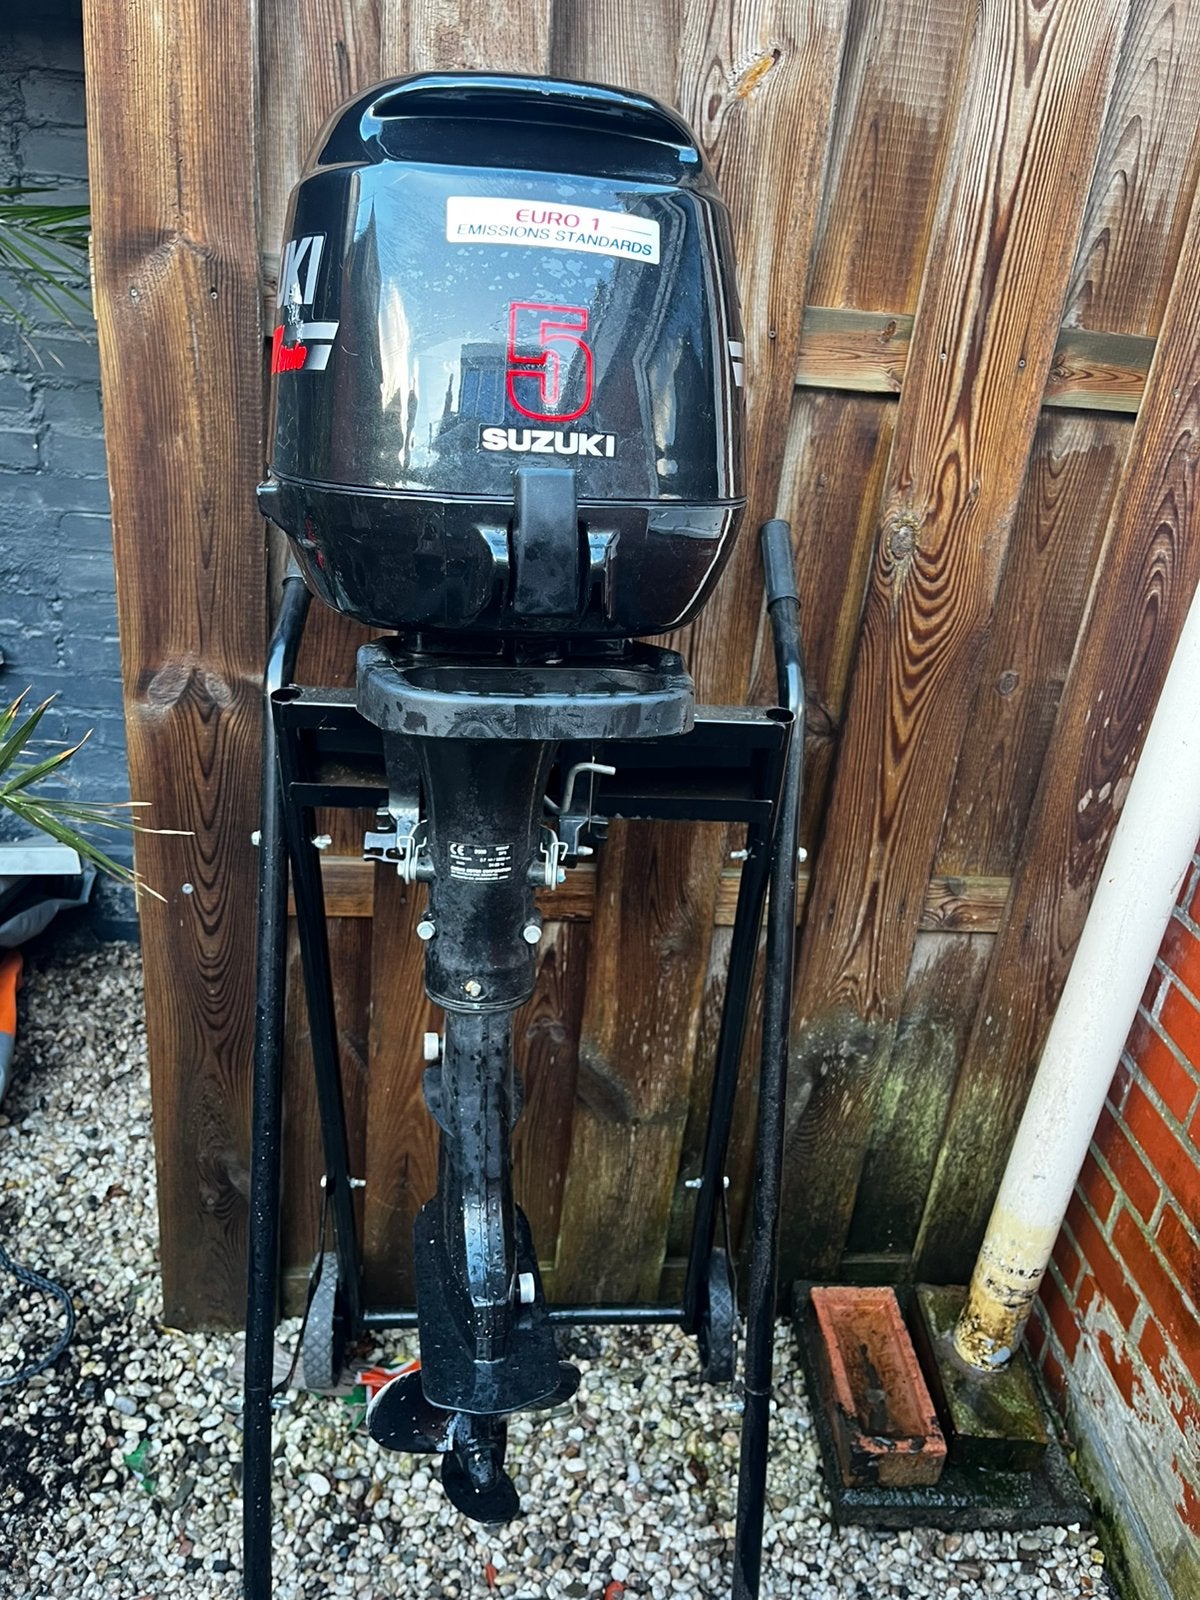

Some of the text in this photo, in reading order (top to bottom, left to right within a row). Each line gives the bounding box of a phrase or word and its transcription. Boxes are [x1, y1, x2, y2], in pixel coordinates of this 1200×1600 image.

[515, 208, 600, 231] EURO 1
[456, 223, 653, 256] EMISSIONS STANDARDS
[506, 301, 593, 423] 5
[482, 428, 616, 458] SUZUKI
